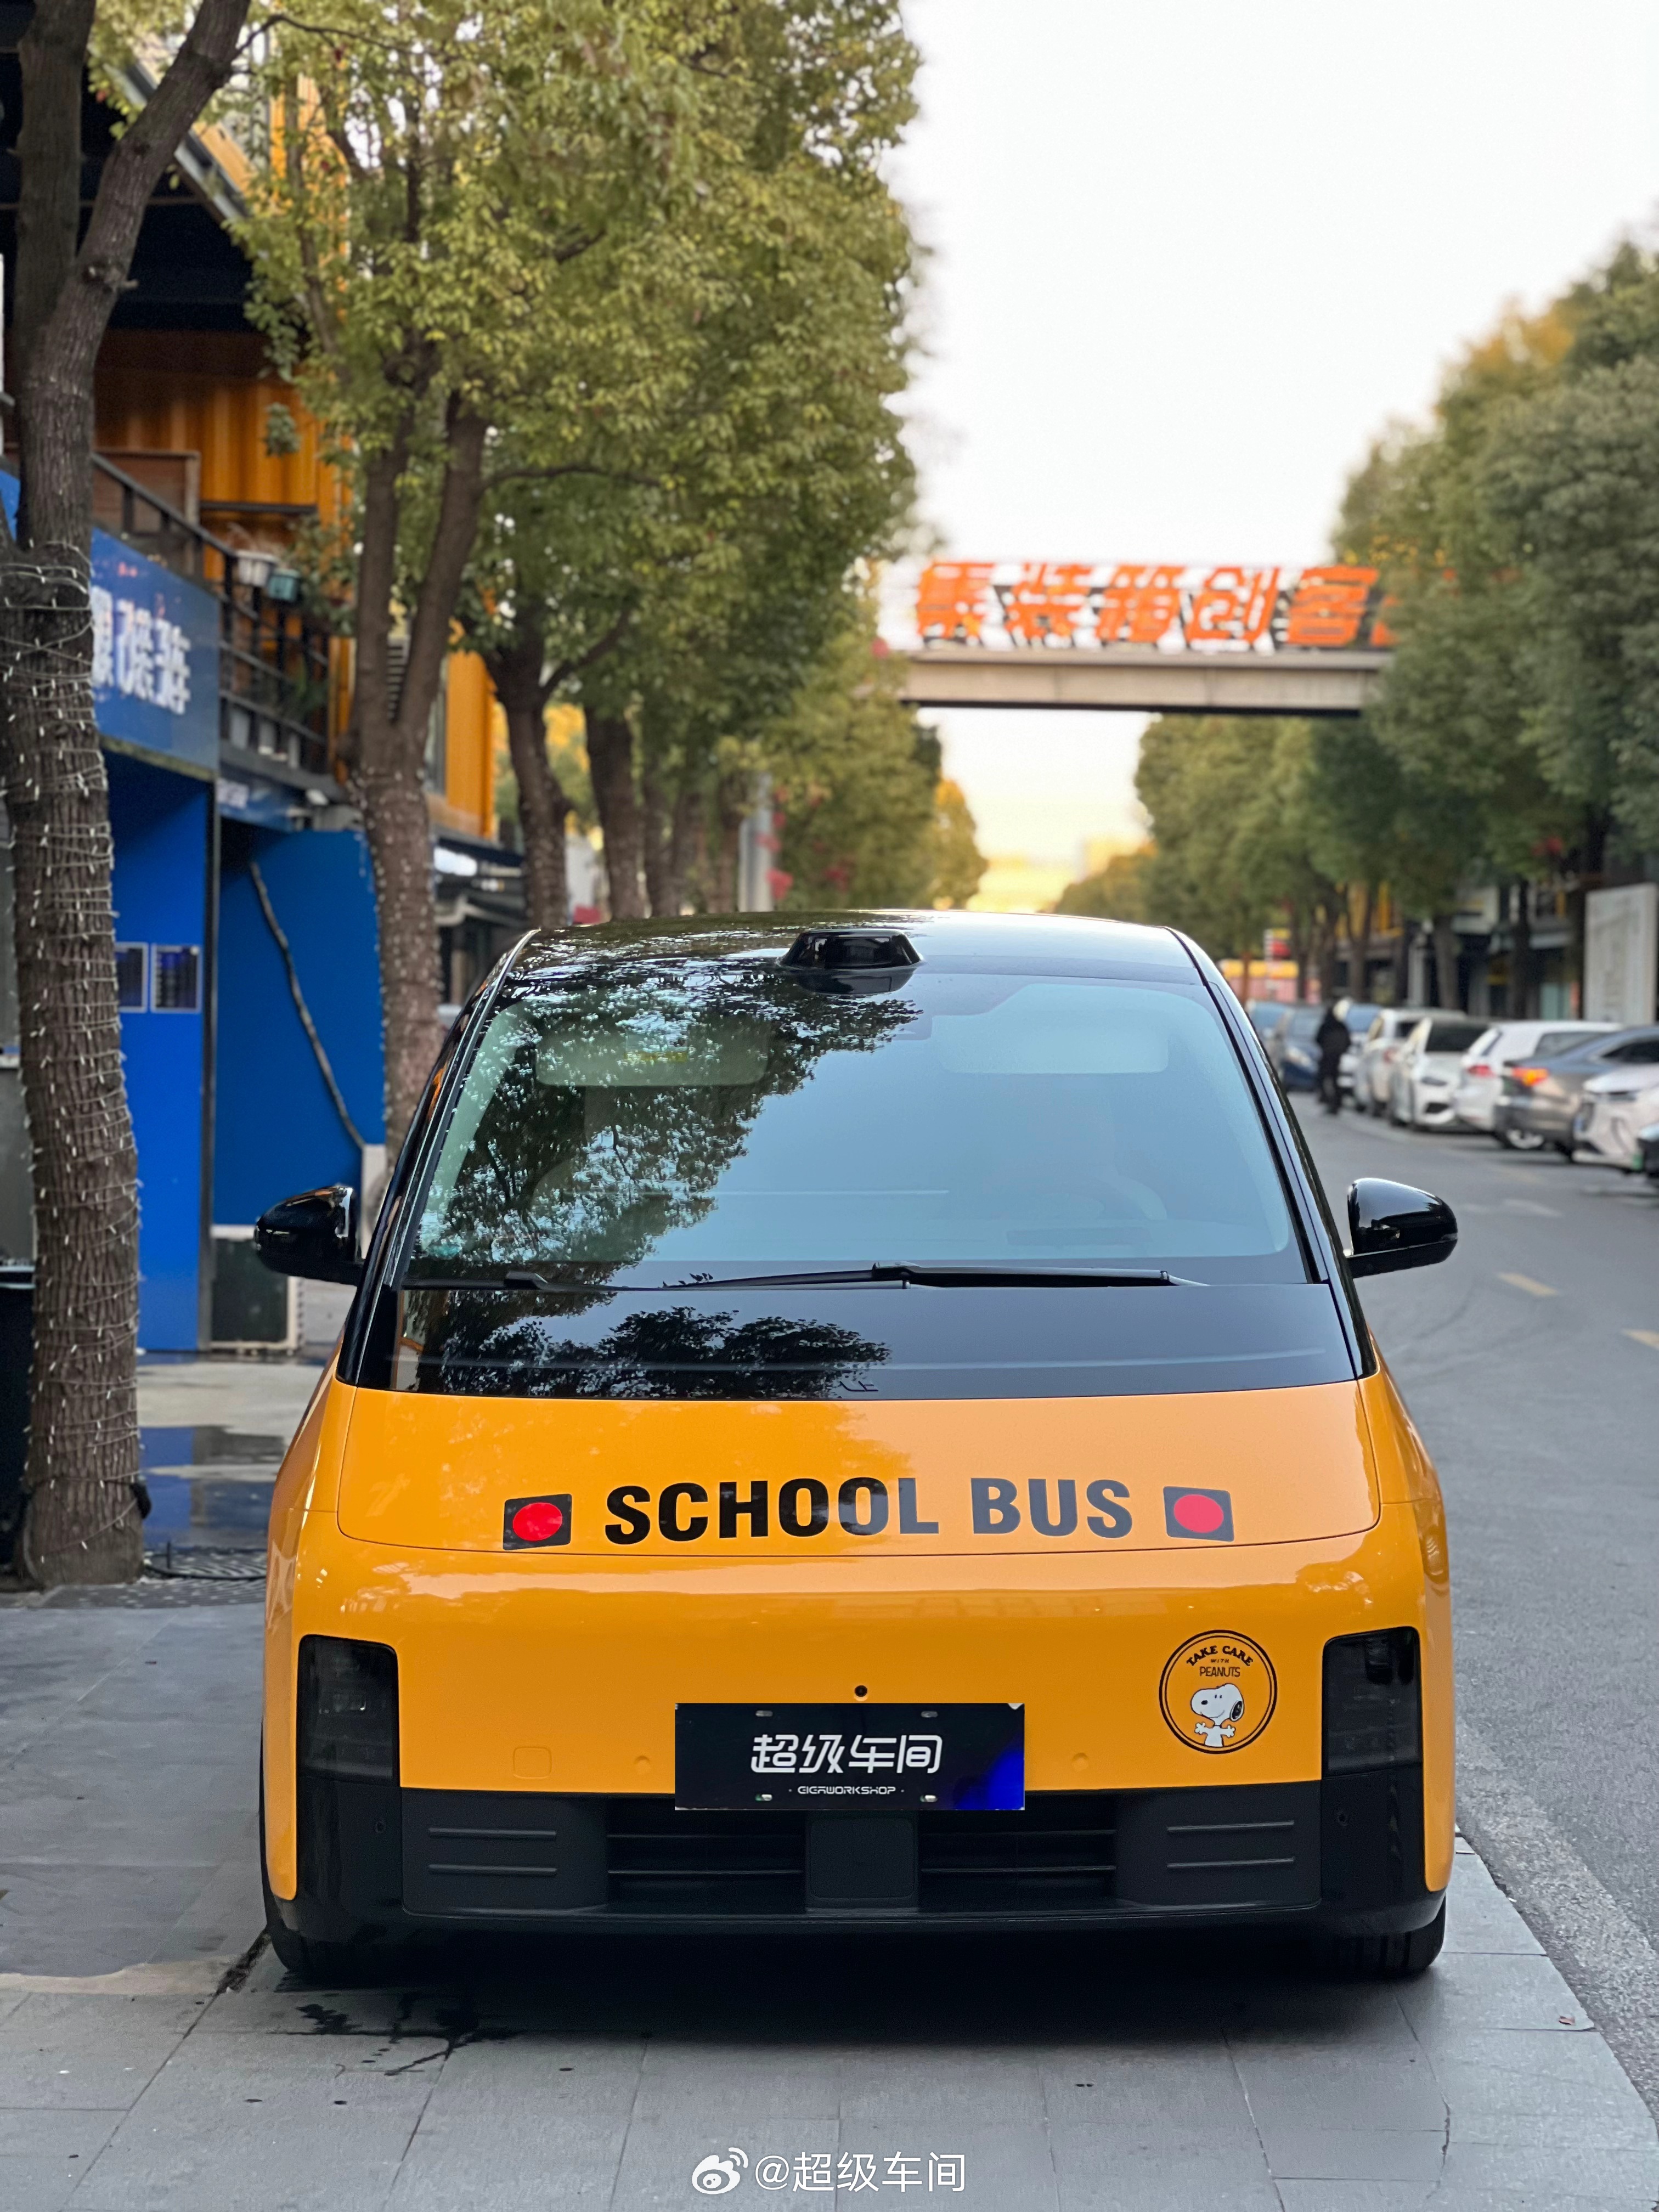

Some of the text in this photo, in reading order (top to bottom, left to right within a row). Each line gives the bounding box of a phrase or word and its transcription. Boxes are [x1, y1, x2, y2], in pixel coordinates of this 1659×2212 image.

[605, 1477, 1132, 1545] SCHOOL BUS
[1186, 1645, 1254, 1667] TAKE CARE
[1200, 1666, 1240, 1678] PEANUTS
[751, 1734, 943, 1774] 超级车间
